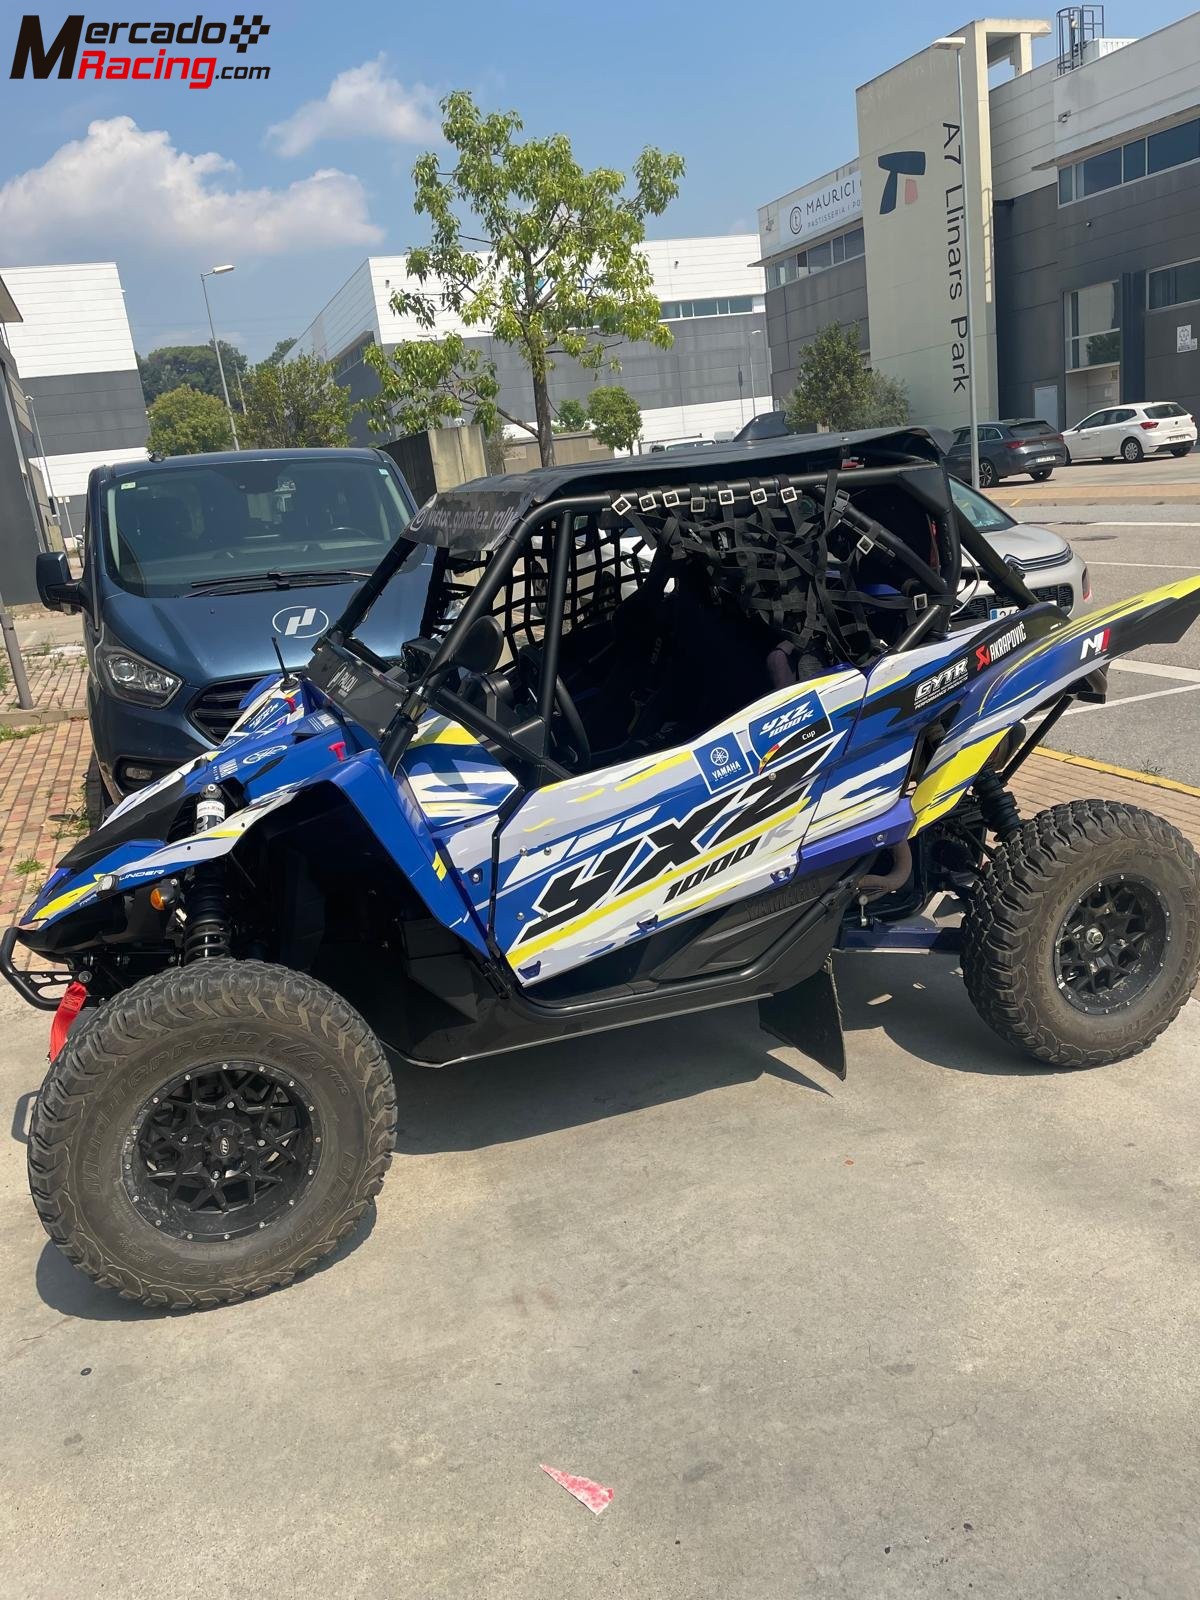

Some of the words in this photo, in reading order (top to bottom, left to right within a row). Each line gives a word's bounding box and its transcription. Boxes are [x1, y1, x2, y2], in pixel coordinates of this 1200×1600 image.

[942, 122, 962, 165] A7
[806, 180, 855, 215] MAURICI
[808, 209, 846, 228] PASTISSERIA
[946, 184, 964, 302] Llinars
[951, 316, 970, 393] Park
[914, 658, 968, 701] GYTR
[759, 701, 812, 736] YXZ
[801, 729, 816, 741] Cup
[711, 760, 741, 779] YAMAHA
[518, 740, 838, 945] YXZ
